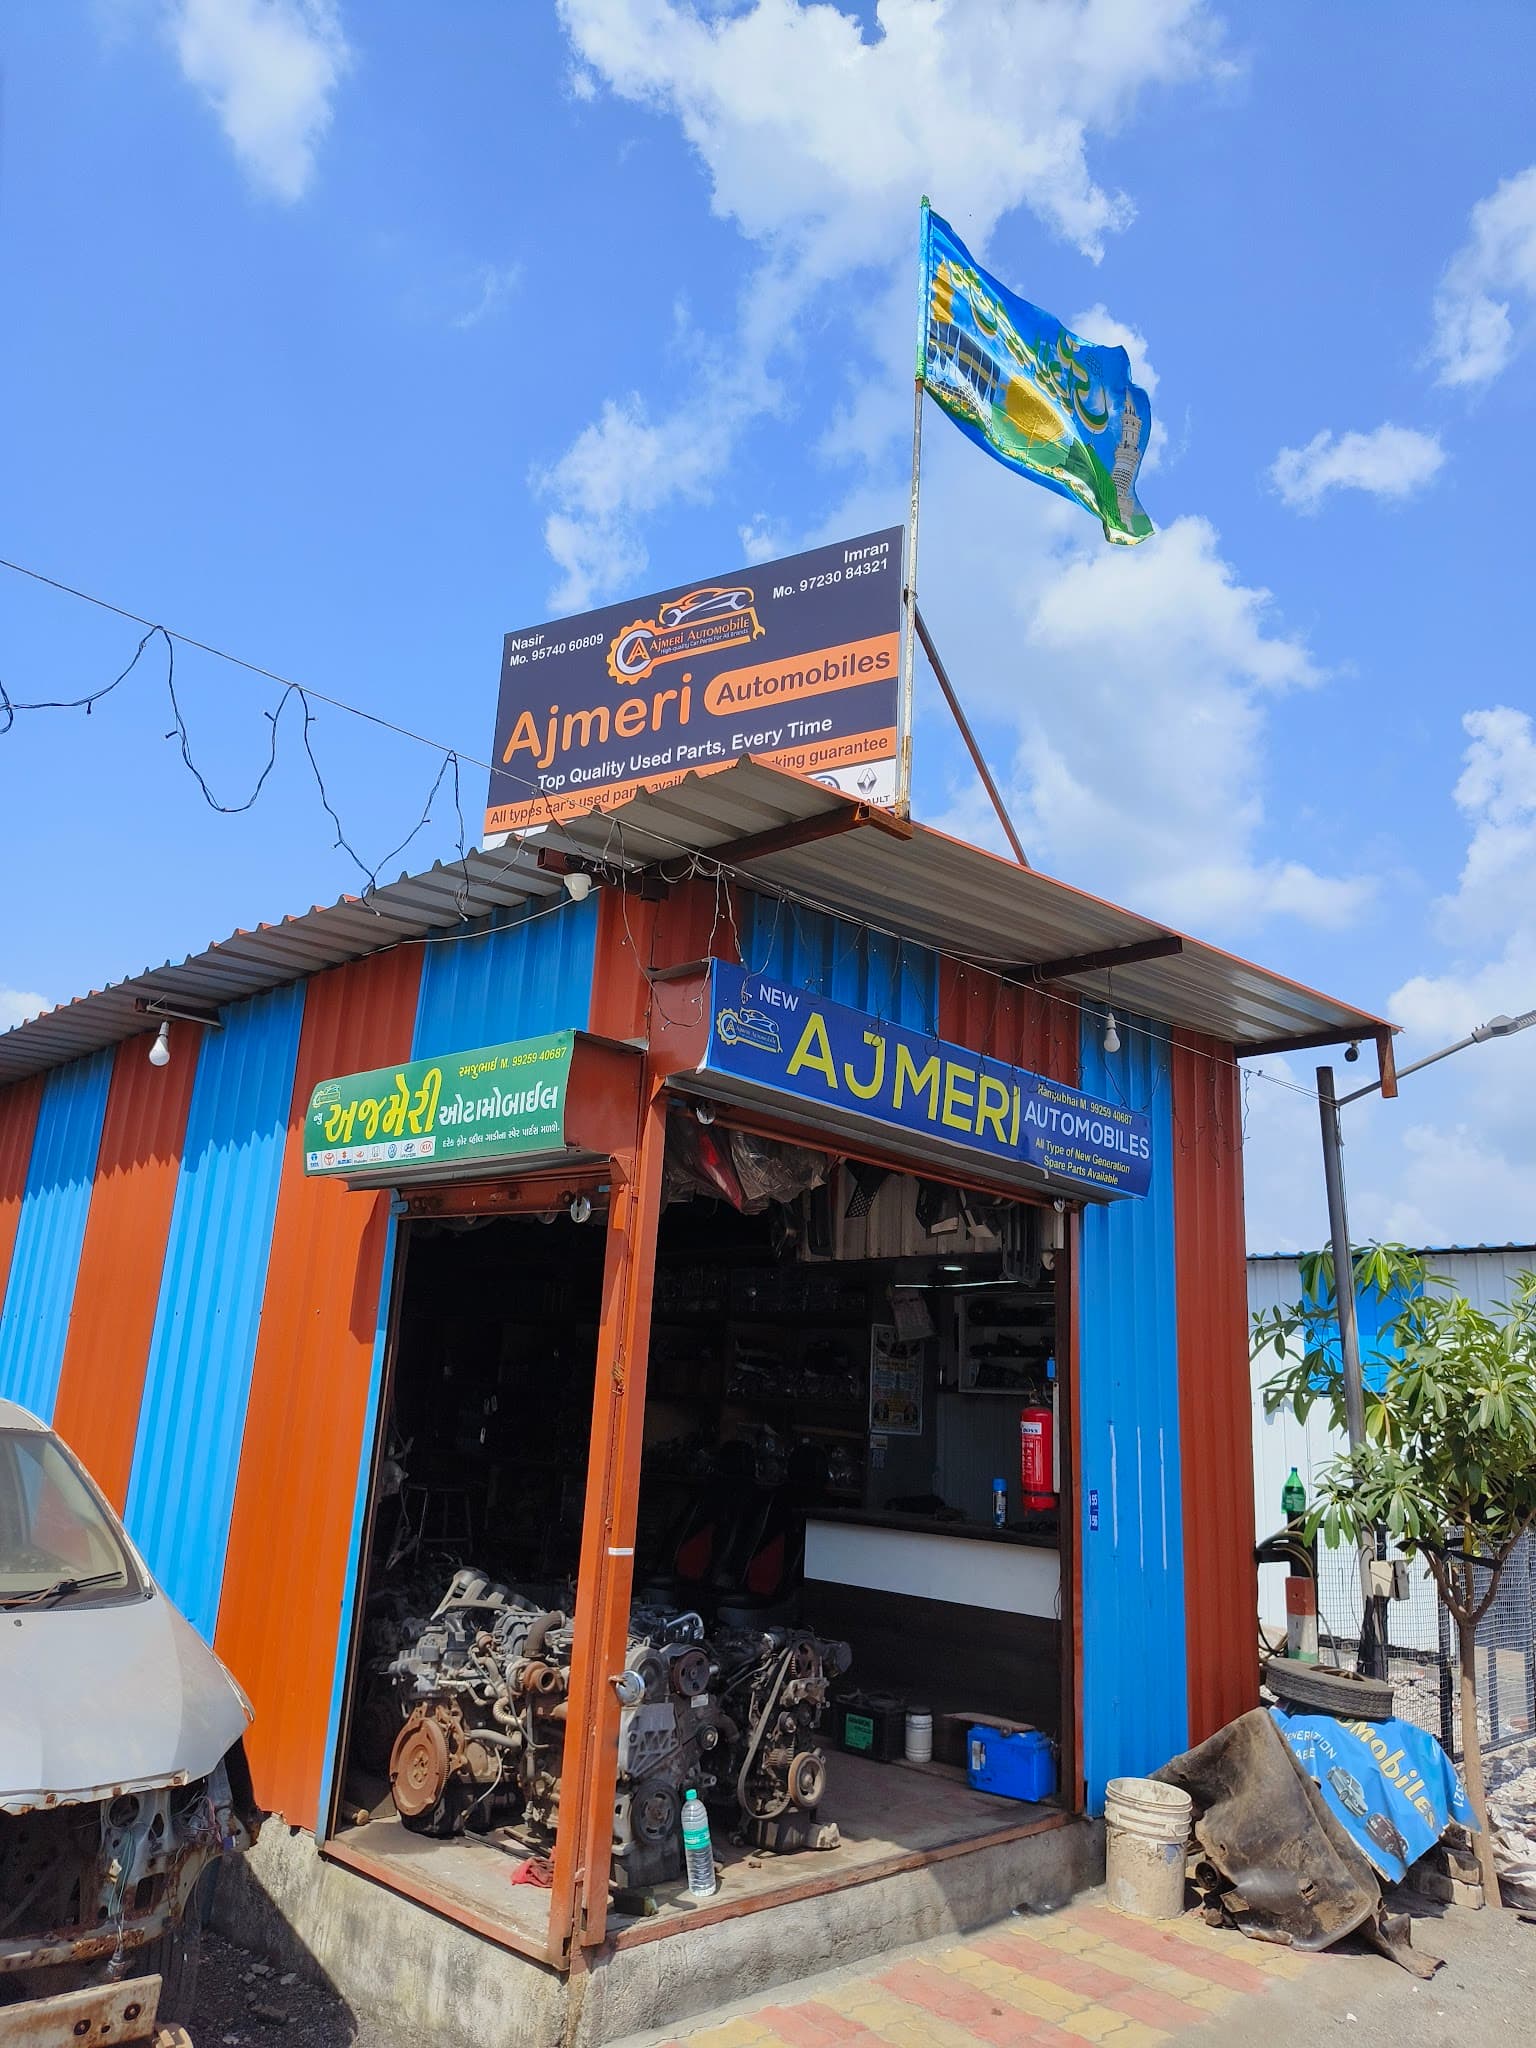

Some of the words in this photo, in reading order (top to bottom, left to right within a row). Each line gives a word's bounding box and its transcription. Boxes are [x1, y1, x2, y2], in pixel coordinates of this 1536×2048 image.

[844, 542, 889, 563] Imran
[773, 585, 796, 599] Mo.
[800, 571, 841, 591] 97230
[845, 558, 887, 580] 84321
[510, 655, 528, 666] Mo.
[531, 643, 566, 660] 95740
[569, 633, 604, 651] 60809
[511, 634, 544, 651] Nasir
[502, 673, 693, 769] Ajmeri
[715, 648, 891, 706] Automobiles
[538, 775, 566, 790] Top
[569, 760, 626, 783] Quality
[629, 748, 672, 771] Used
[677, 741, 726, 762] Parts,
[732, 729, 783, 751] Every
[787, 718, 833, 739] Time
[490, 811, 507, 825] All
[510, 806, 542, 823] types
[546, 797, 576, 814] car's
[579, 791, 609, 808] used
[809, 736, 888, 766] guarantee
[759, 983, 799, 1012] NEW
[512, 1052, 538, 1067] 99259
[539, 1047, 567, 1061] 40687
[786, 1012, 1021, 1147] AJMERI
[325, 1067, 442, 1143] અજમેરી
[1090, 1102, 1111, 1118] 99259
[1112, 1110, 1132, 1126] 40687
[1024, 1100, 1150, 1160] AUTOMOBILES
[1035, 1137, 1044, 1149] All
[1046, 1140, 1064, 1155] Type
[1065, 1146, 1074, 1158] of
[1075, 1149, 1091, 1163] New
[1092, 1153, 1130, 1174] Generation
[1043, 1155, 1066, 1171] Spare
[1067, 1163, 1086, 1177] Parts
[1087, 1168, 1119, 1185] Available
